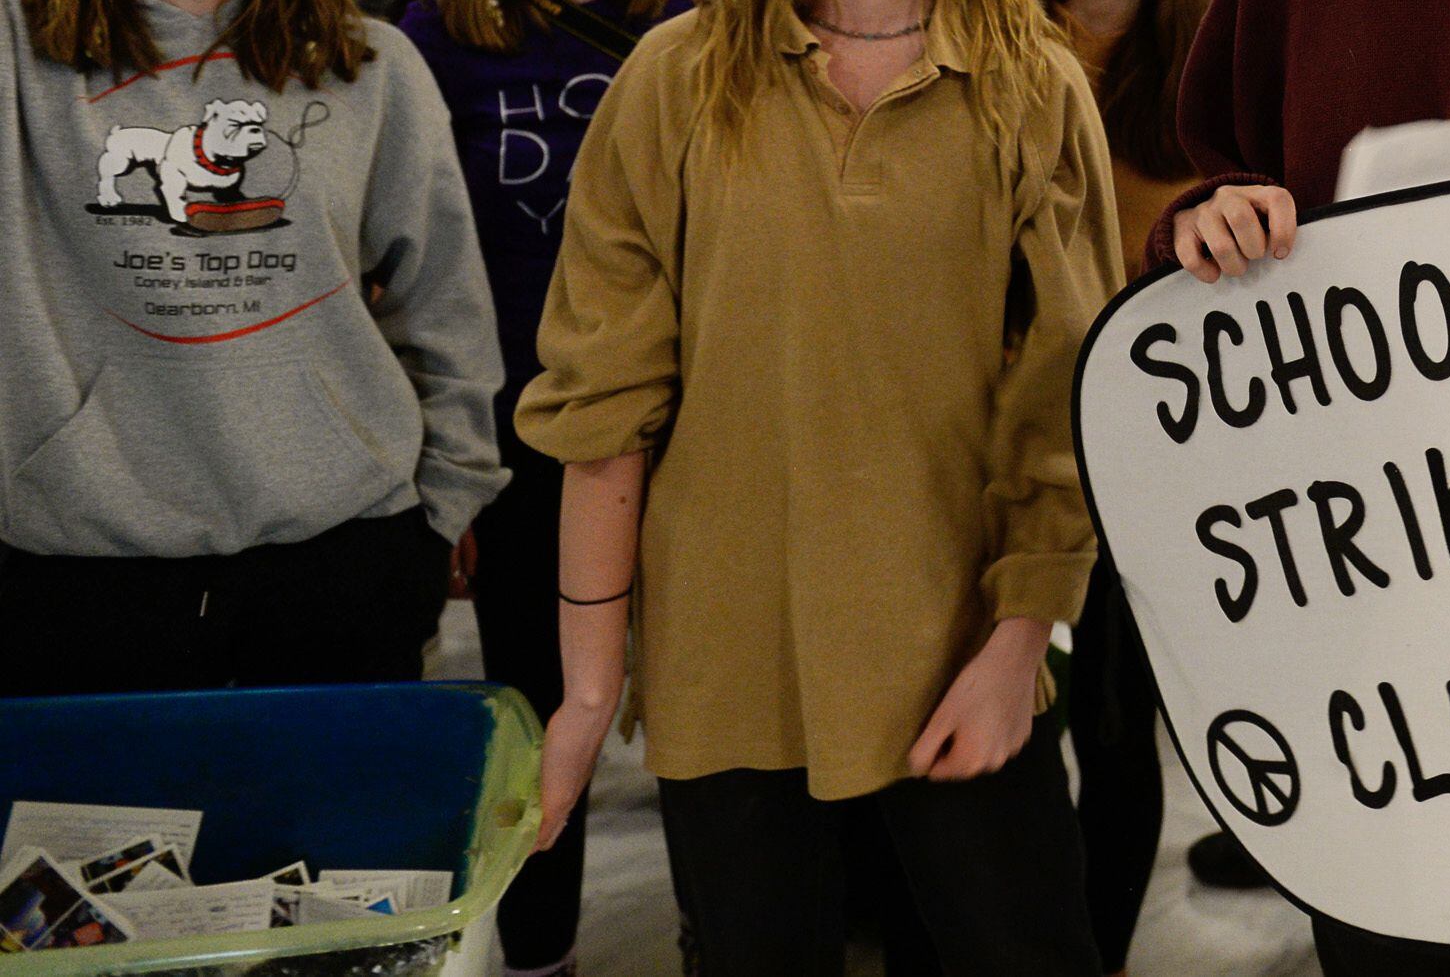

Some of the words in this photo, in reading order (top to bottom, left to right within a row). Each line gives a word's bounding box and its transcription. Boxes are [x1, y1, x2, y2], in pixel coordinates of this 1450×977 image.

[113, 250, 186, 272] Joe's
[195, 253, 240, 274] Top
[247, 250, 297, 272] Dog
[134, 276, 180, 290] Coney
[184, 276, 230, 288] Island
[245, 275, 272, 287] Bar
